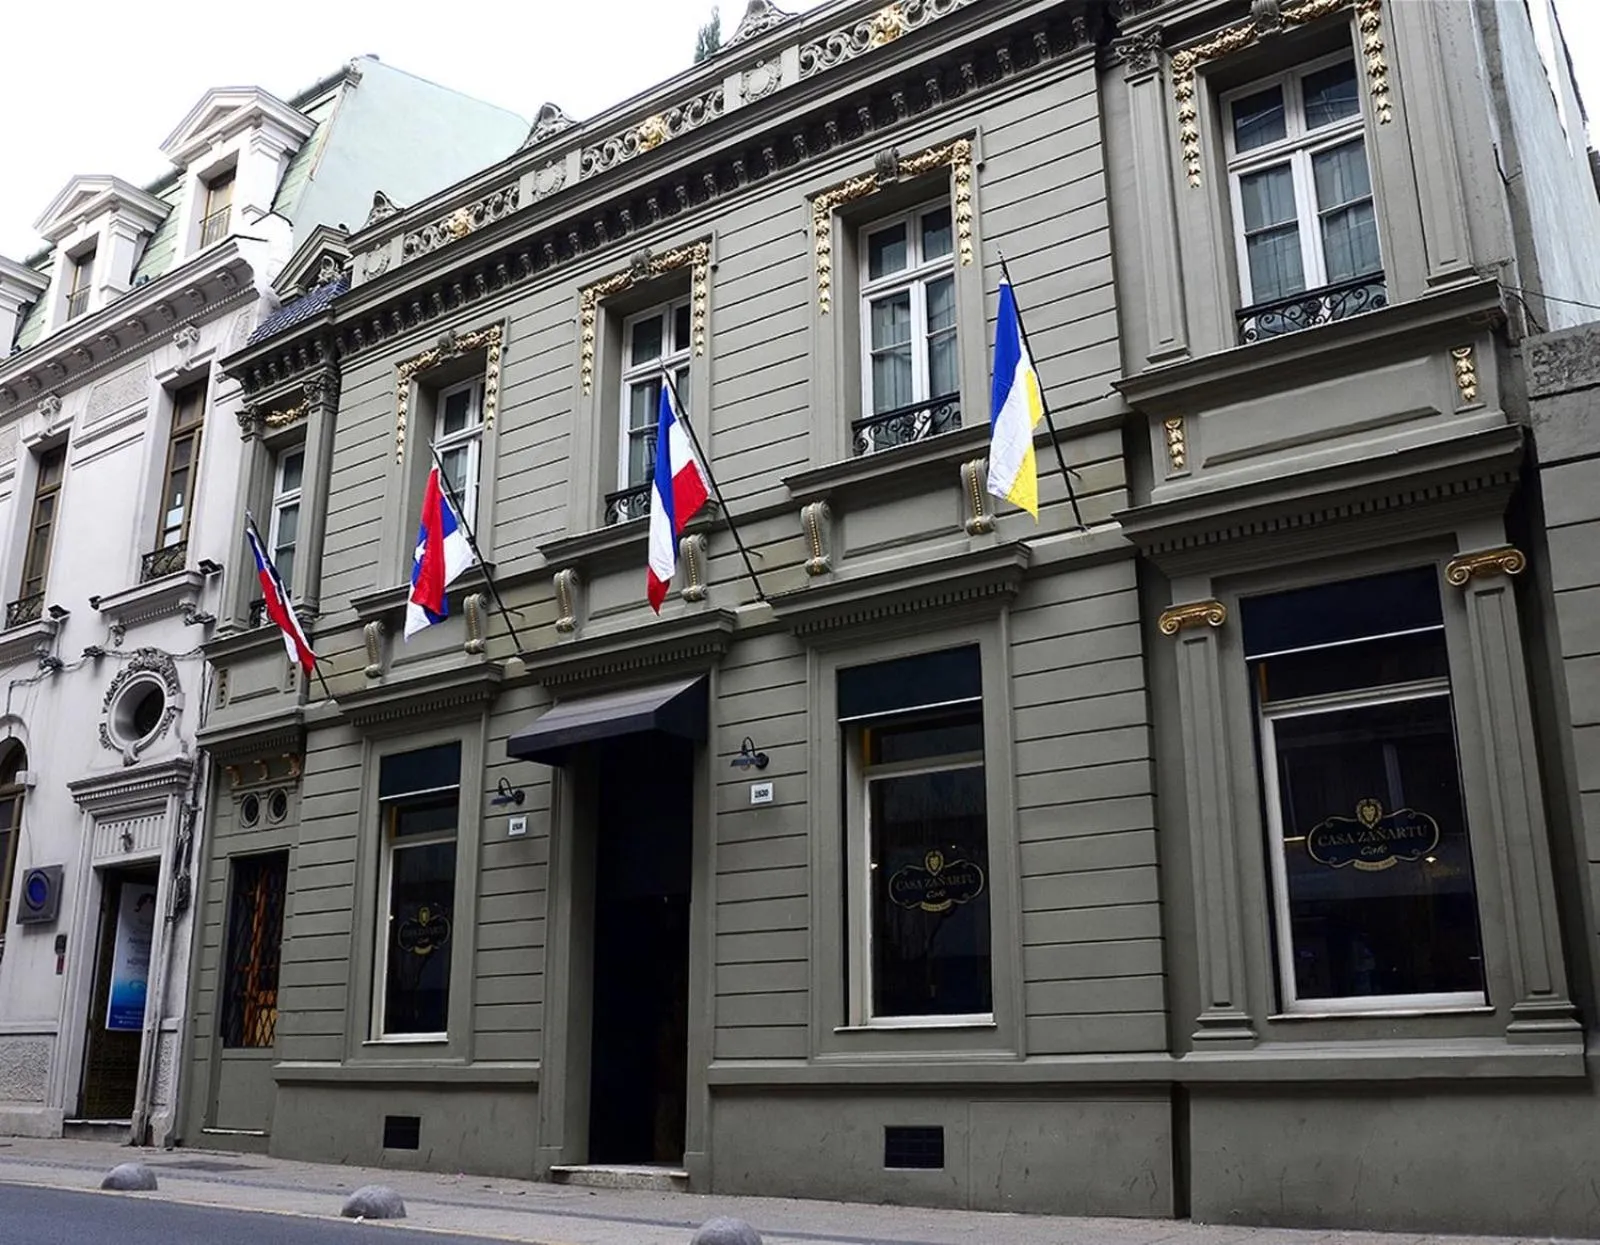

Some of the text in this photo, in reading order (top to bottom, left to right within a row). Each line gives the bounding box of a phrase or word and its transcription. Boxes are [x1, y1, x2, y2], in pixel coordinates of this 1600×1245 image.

[1318, 825, 1427, 846] CASA ZAÑARTU
[895, 879, 923, 891] CASA
